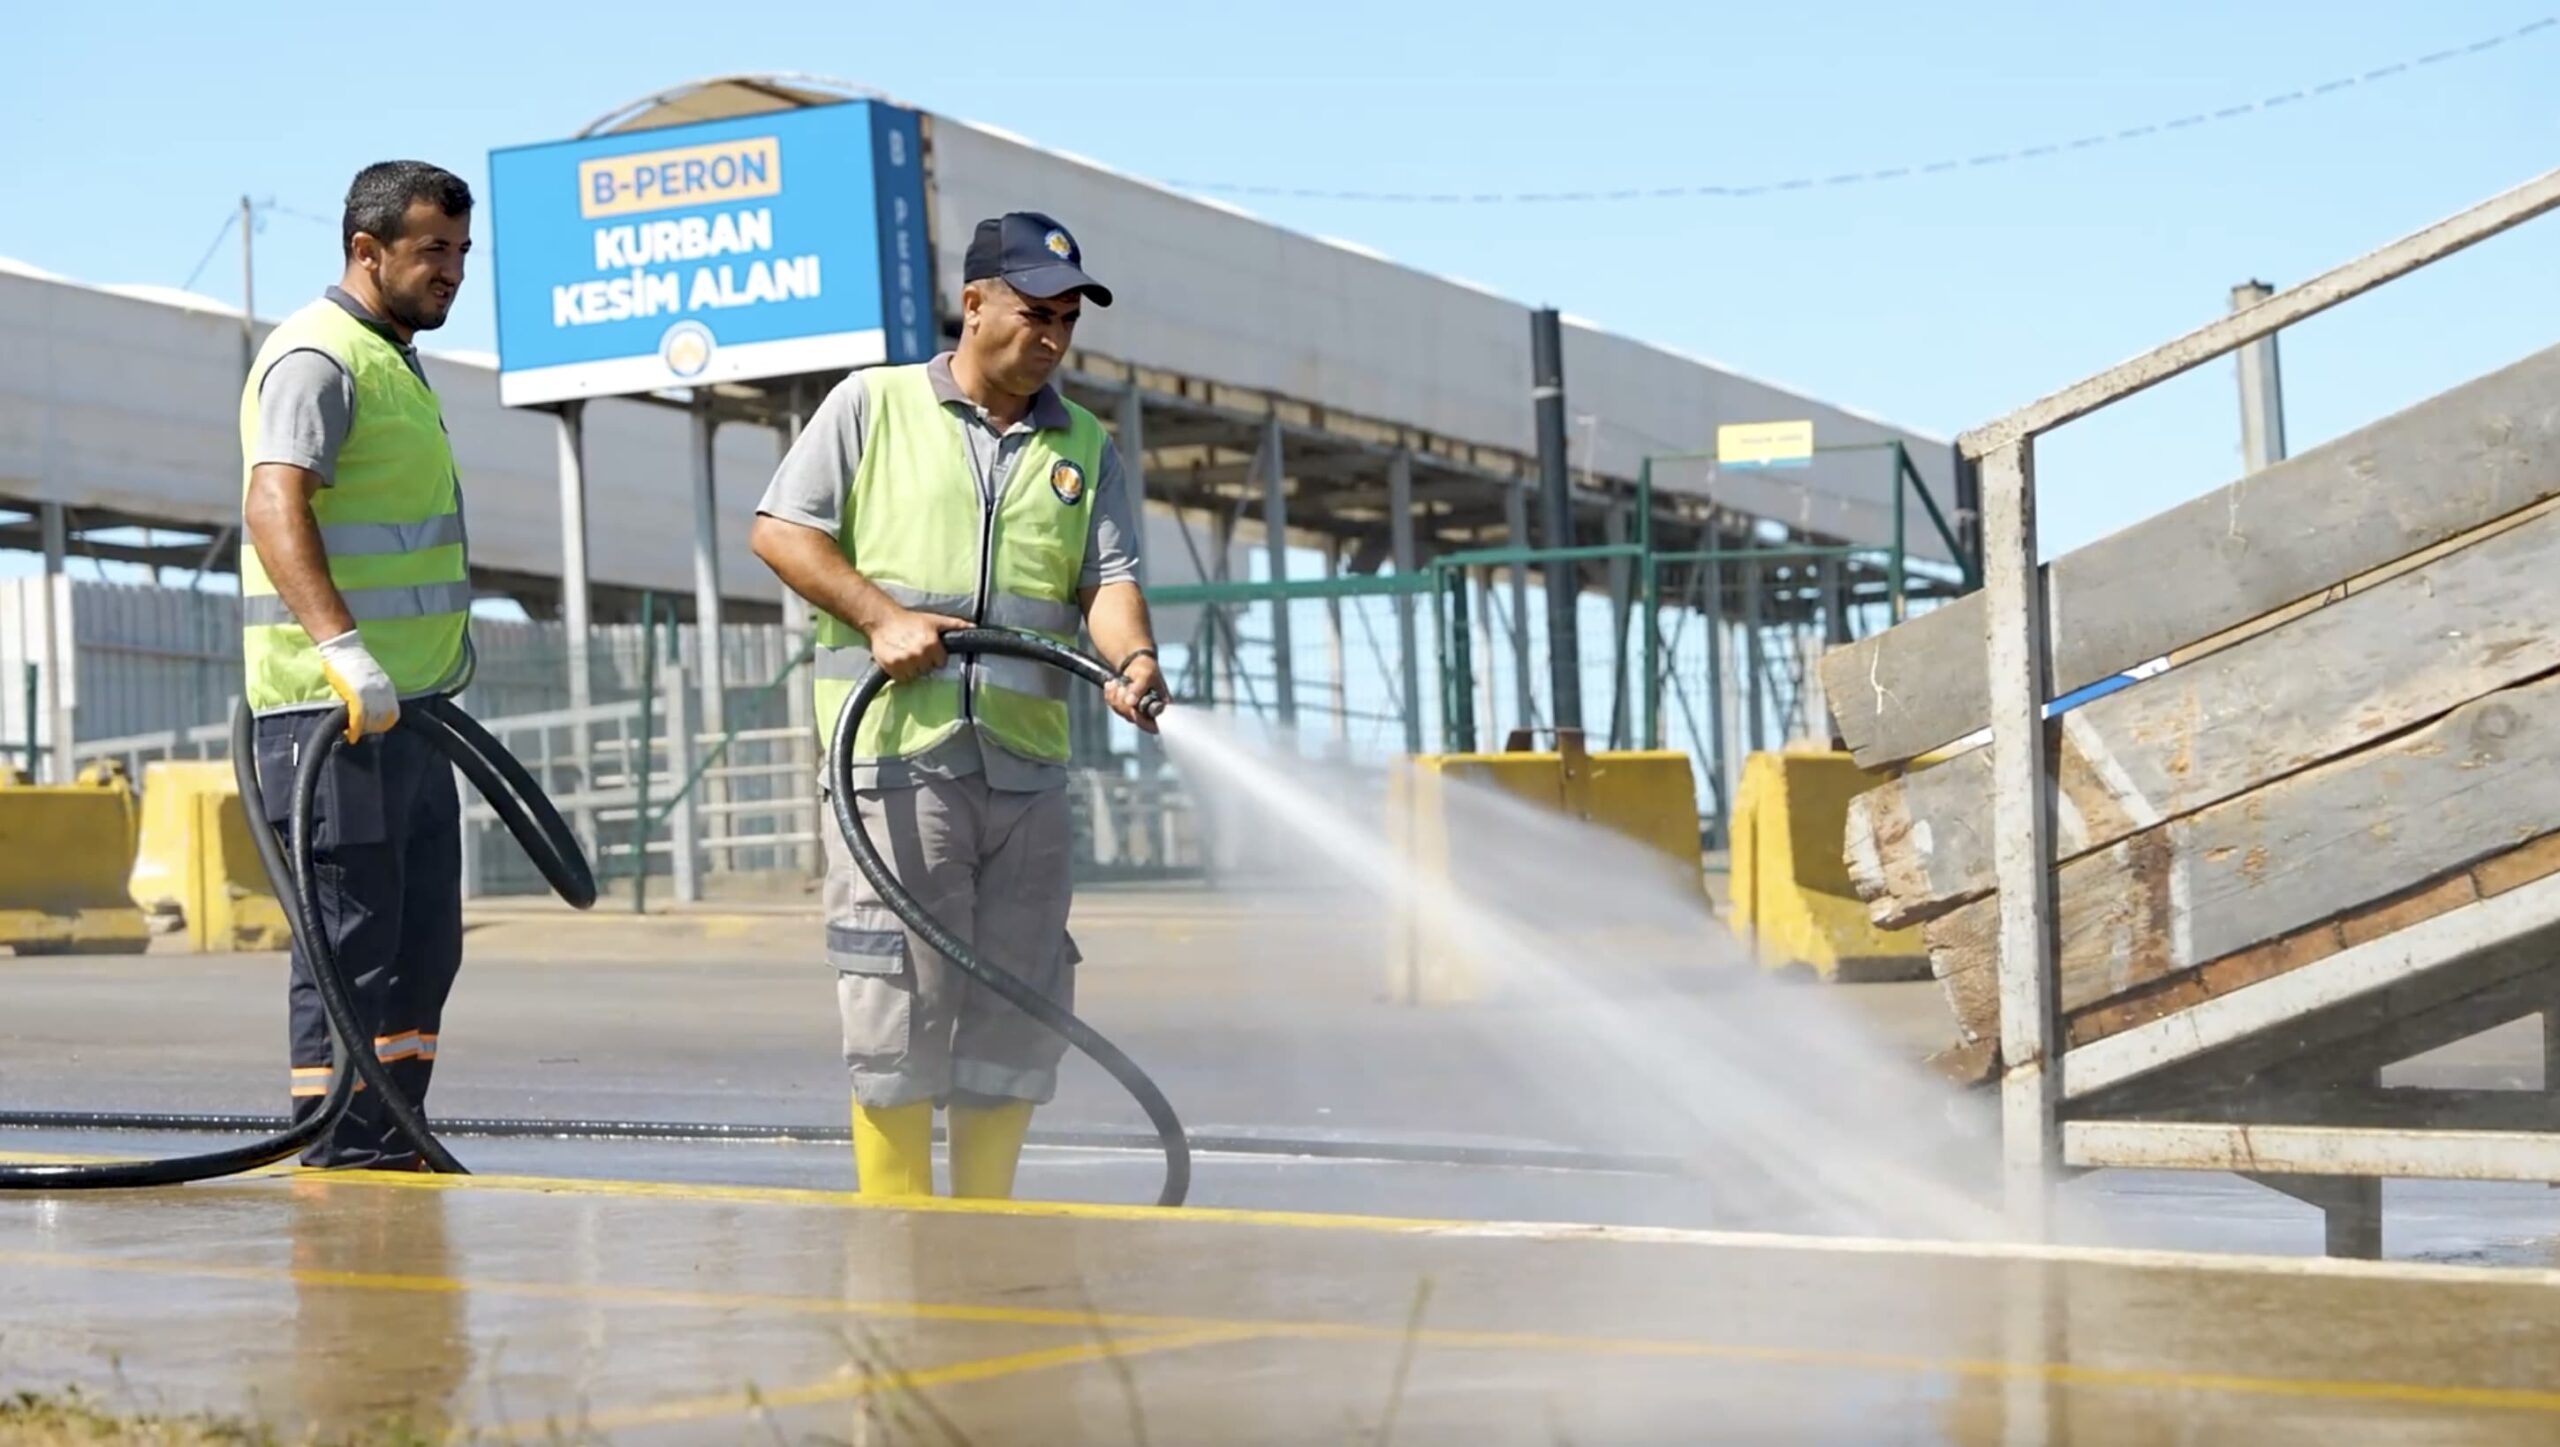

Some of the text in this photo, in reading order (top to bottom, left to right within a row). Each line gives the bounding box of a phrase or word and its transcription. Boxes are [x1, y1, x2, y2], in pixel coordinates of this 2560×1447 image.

[592, 150, 768, 205] B-PERON
[594, 209, 772, 270] KURBAN
[552, 255, 821, 327] KESİM ALANI
